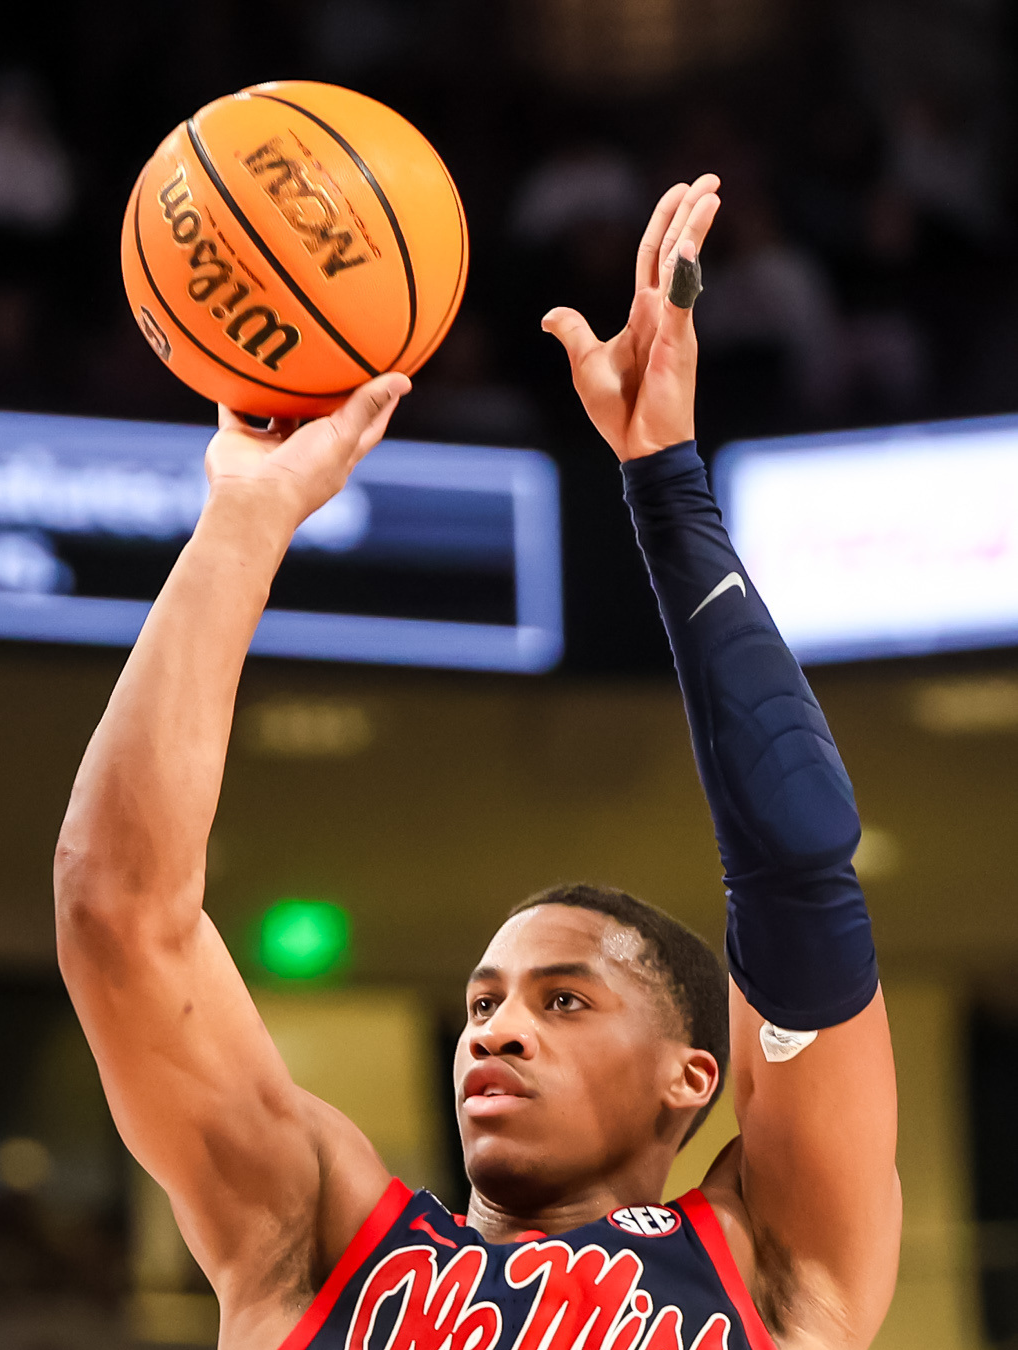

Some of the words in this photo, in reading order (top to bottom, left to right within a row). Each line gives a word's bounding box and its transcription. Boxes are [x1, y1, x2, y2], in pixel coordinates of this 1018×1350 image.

[157, 164, 302, 372] Wilson
[239, 135, 371, 280] NCAA
[610, 1205, 677, 1236] SEC
